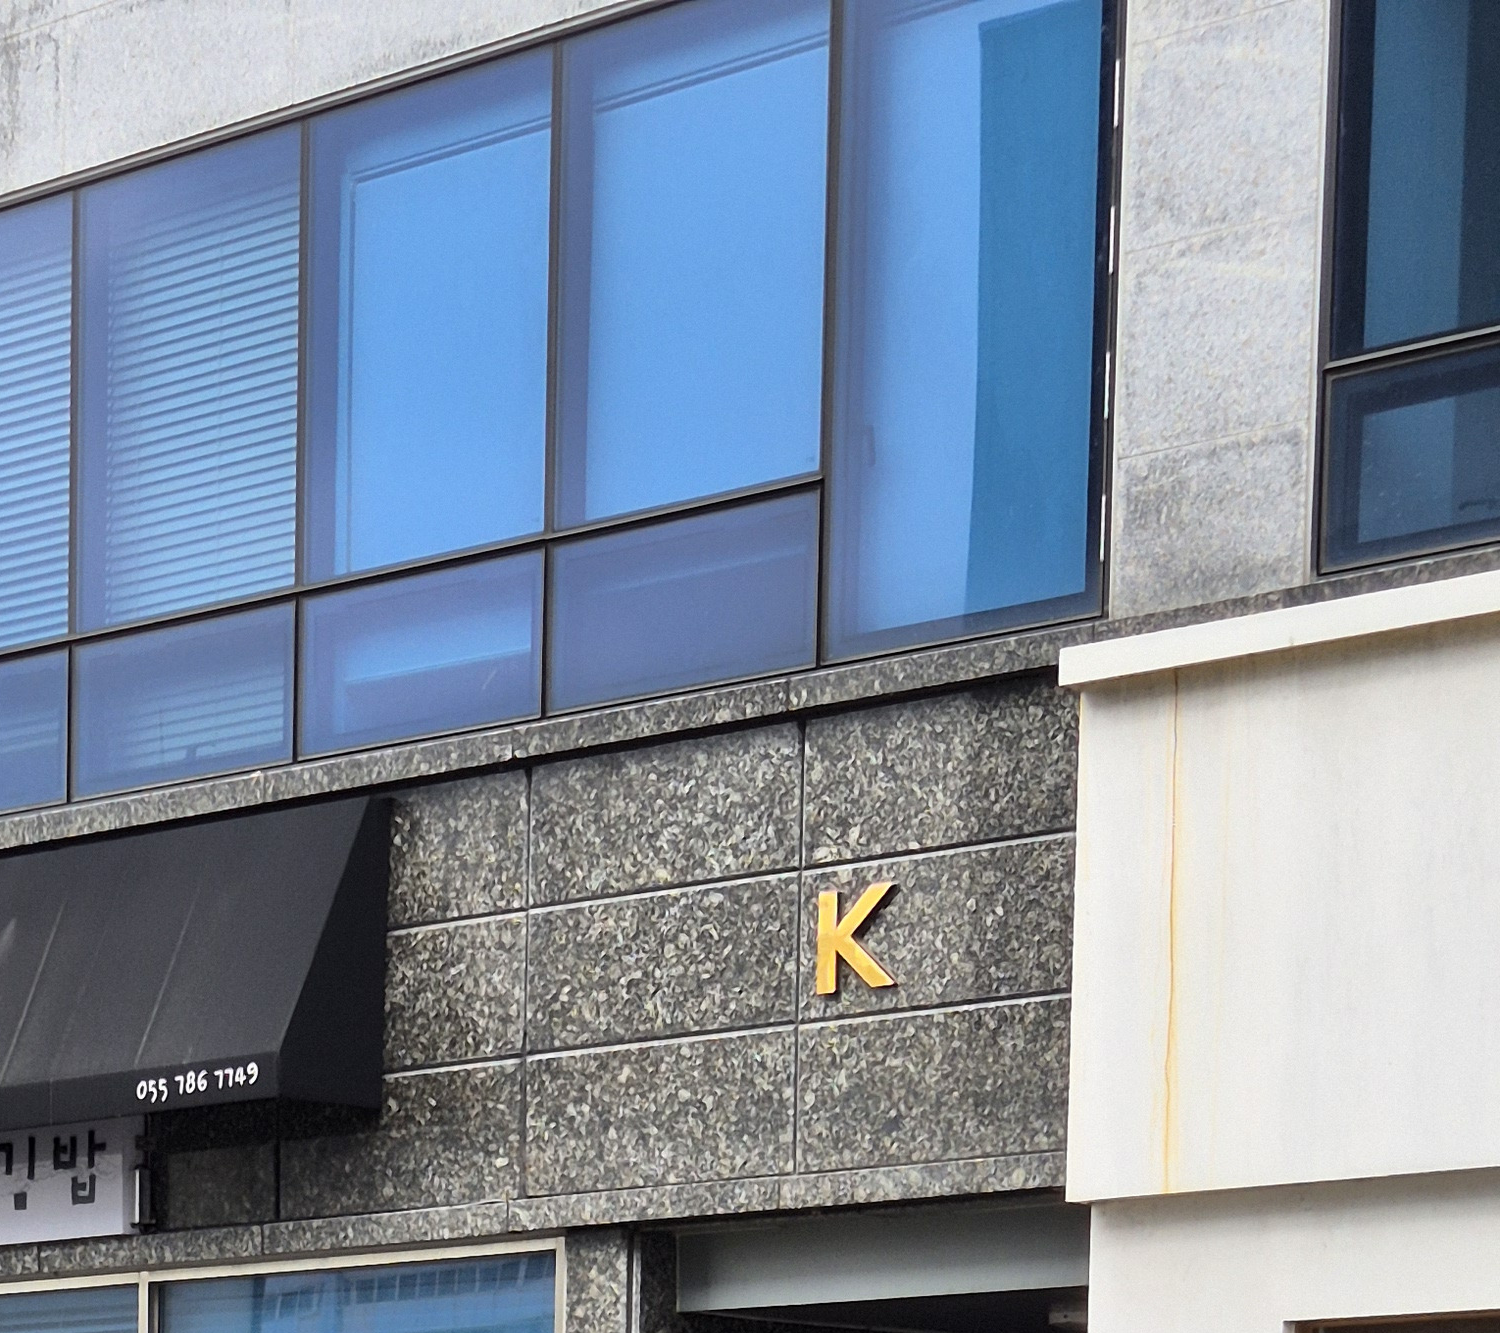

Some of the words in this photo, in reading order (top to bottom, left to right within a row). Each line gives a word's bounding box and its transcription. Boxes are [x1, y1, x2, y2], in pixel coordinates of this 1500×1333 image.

[816, 882, 896, 996] K
[136, 1080, 168, 1103] 055
[174, 1069, 208, 1095] 786
[214, 1061, 259, 1089] 7749
